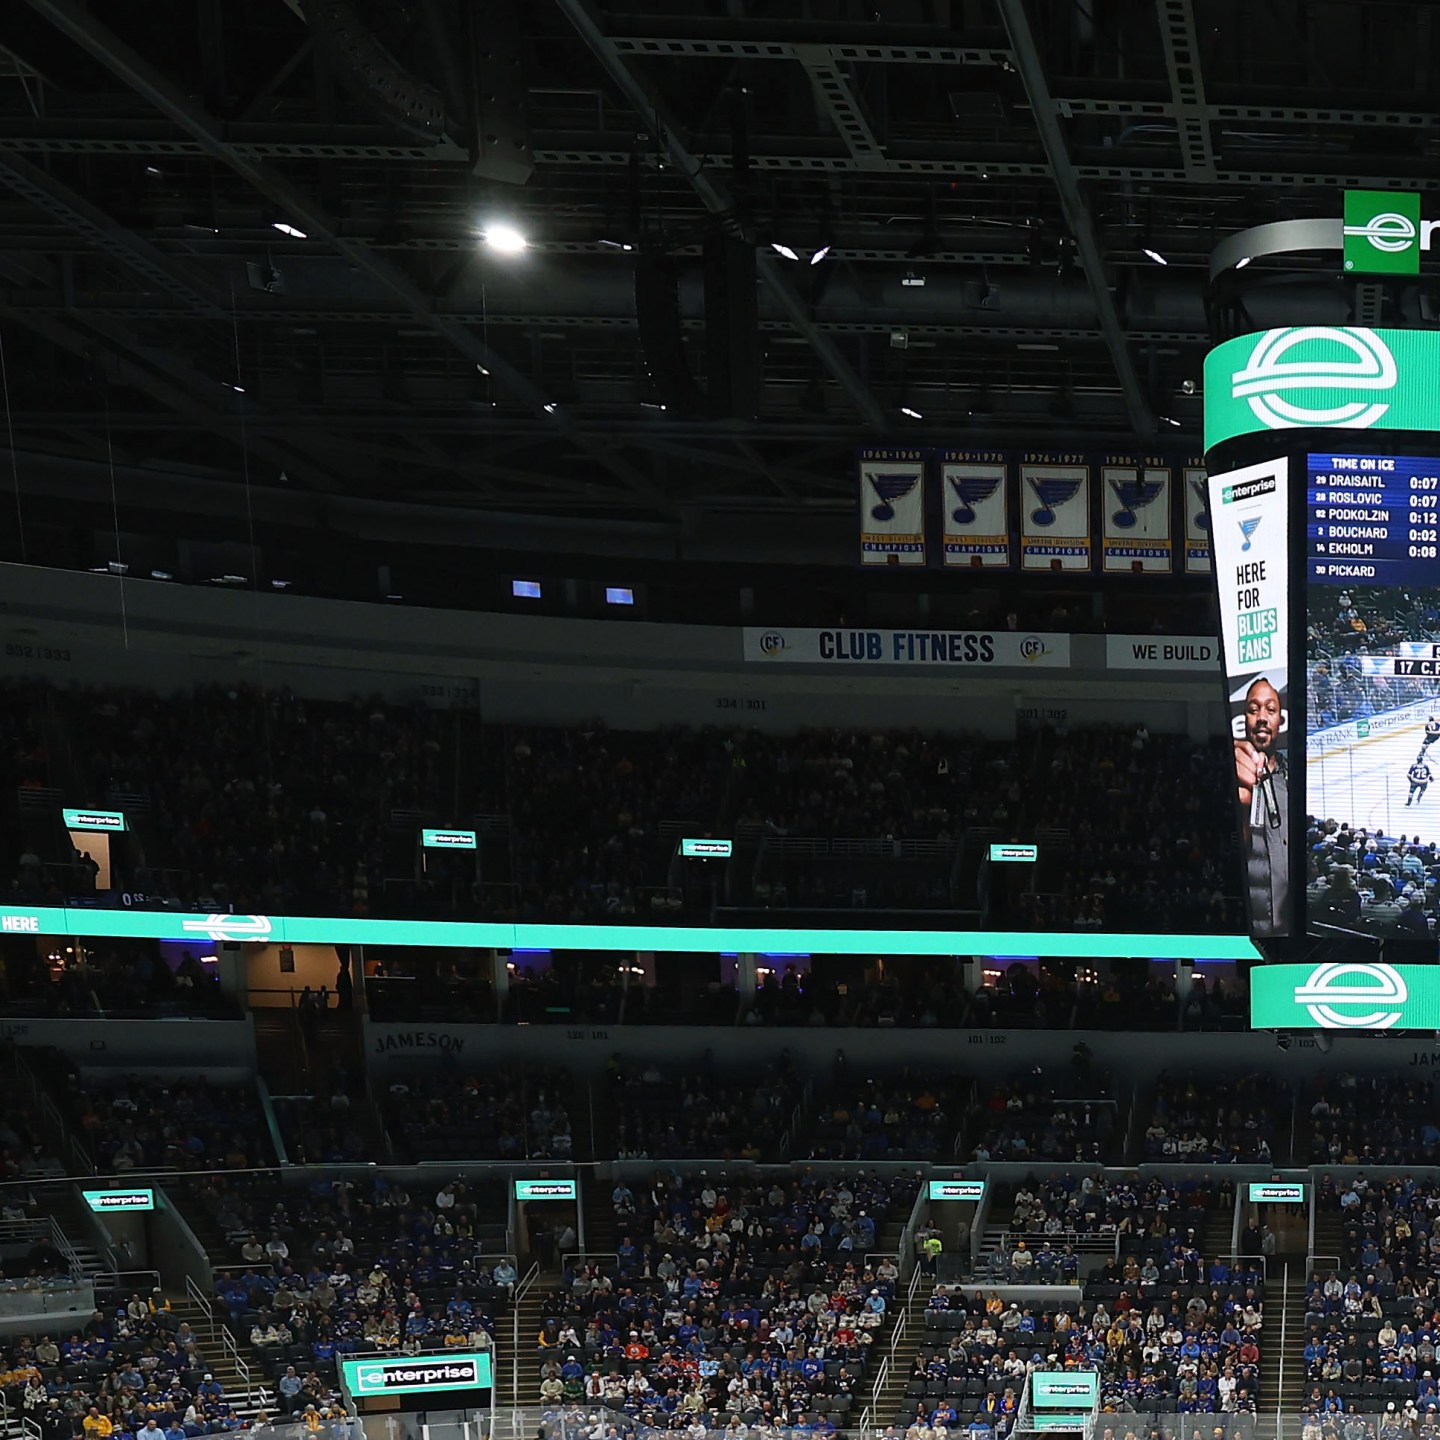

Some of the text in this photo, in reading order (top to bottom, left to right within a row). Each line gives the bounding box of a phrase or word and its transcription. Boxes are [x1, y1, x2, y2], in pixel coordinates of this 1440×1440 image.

[1332, 458, 1395, 471] TIME ON ICE
[1222, 478, 1276, 500] enterprise
[1329, 475, 1438, 489] DRAISAITL 0:07
[1329, 492, 1438, 507] ROSLOVIC 0:07
[1329, 509, 1438, 524] PODKOLZIN 0:12
[1329, 526, 1388, 539] BOUCHARD
[1409, 529, 1437, 542] 0:02
[864, 543, 922, 552] CHAMPIONS
[947, 545, 1006, 553] CHAMPIONS
[1026, 546, 1087, 556] CHAMPIONS
[1108, 548, 1168, 557] CHAMPIONS
[1328, 542, 1373, 555] EKHOLM
[1408, 546, 1437, 558] 0:08
[1236, 561, 1266, 585] HERE
[1328, 565, 1375, 577] PICKARD
[1238, 588, 1260, 610] FOR
[1238, 609, 1278, 635] BLUES
[819, 631, 994, 662] CLUB FITNESS
[1132, 645, 1211, 661] WE BUILD
[1238, 636, 1272, 662] FANS
[1399, 661, 1413, 674] 17
[1, 916, 39, 932] HERE
[375, 1031, 465, 1053] JAMESON
[366, 1366, 474, 1384] enterprise
[1041, 1385, 1090, 1395] enterprise
